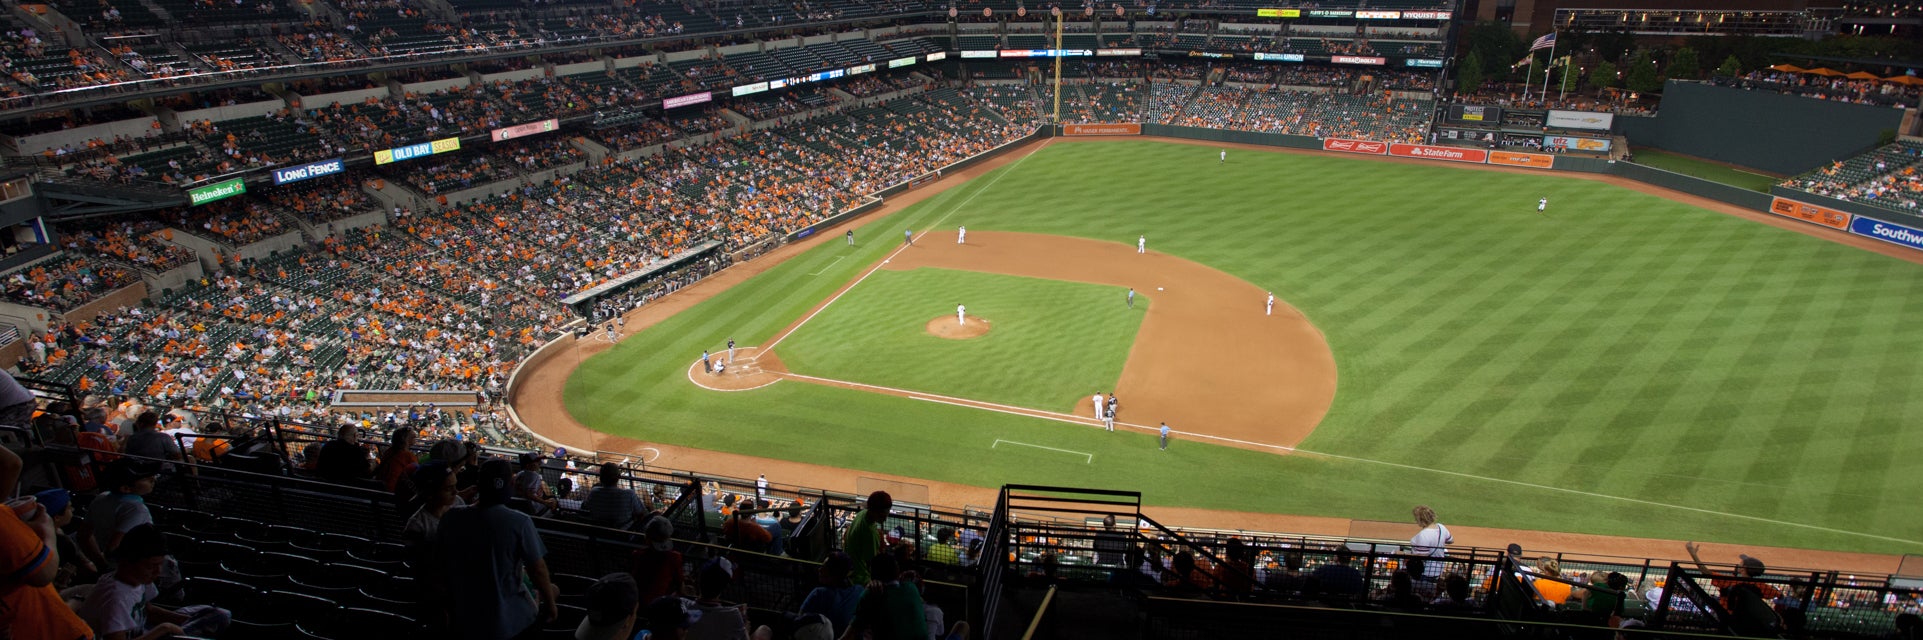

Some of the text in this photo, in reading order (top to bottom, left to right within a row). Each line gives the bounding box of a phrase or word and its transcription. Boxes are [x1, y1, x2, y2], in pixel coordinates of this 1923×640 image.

[1284, 53, 1304, 62] UNION
[1463, 105, 1485, 113] PROTECT
[1552, 137, 1569, 145] utz
[394, 147, 413, 160] OLD
[413, 143, 430, 157] BAY
[433, 139, 458, 153] SEASON
[278, 161, 341, 183] LONG FENCE
[191, 183, 234, 203] Heineken
